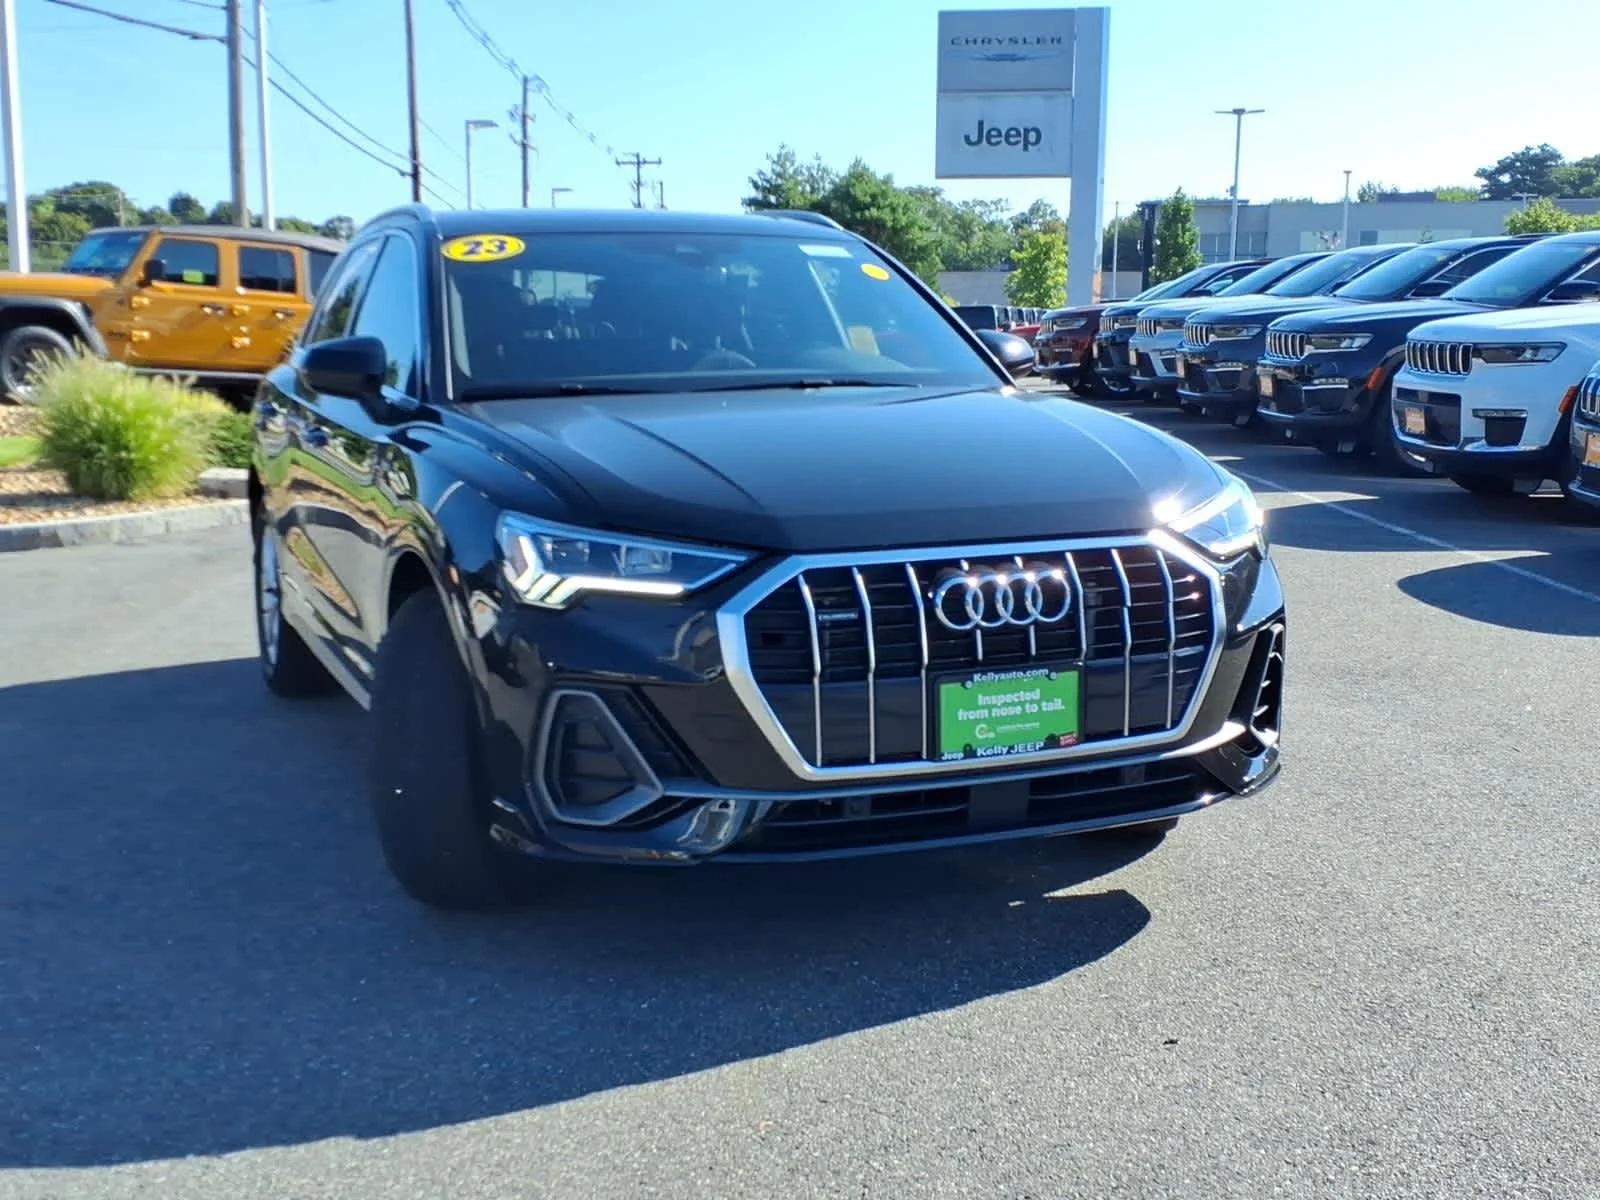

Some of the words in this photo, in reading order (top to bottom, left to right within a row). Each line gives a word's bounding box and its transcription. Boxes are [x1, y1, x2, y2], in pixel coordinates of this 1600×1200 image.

[950, 35, 1063, 47] CHRYSLER
[963, 119, 1042, 153] Jeep
[462, 238, 507, 256] 23
[972, 668, 1049, 682] Kellyauto.com
[977, 688, 1041, 706] Inspected
[957, 708, 989, 721] from
[992, 705, 1022, 717] nose
[1025, 702, 1039, 713] to
[1041, 698, 1065, 712] tail.
[941, 752, 965, 761] Jeep
[976, 745, 1009, 757] Kelly
[1010, 741, 1045, 754] JEEP
